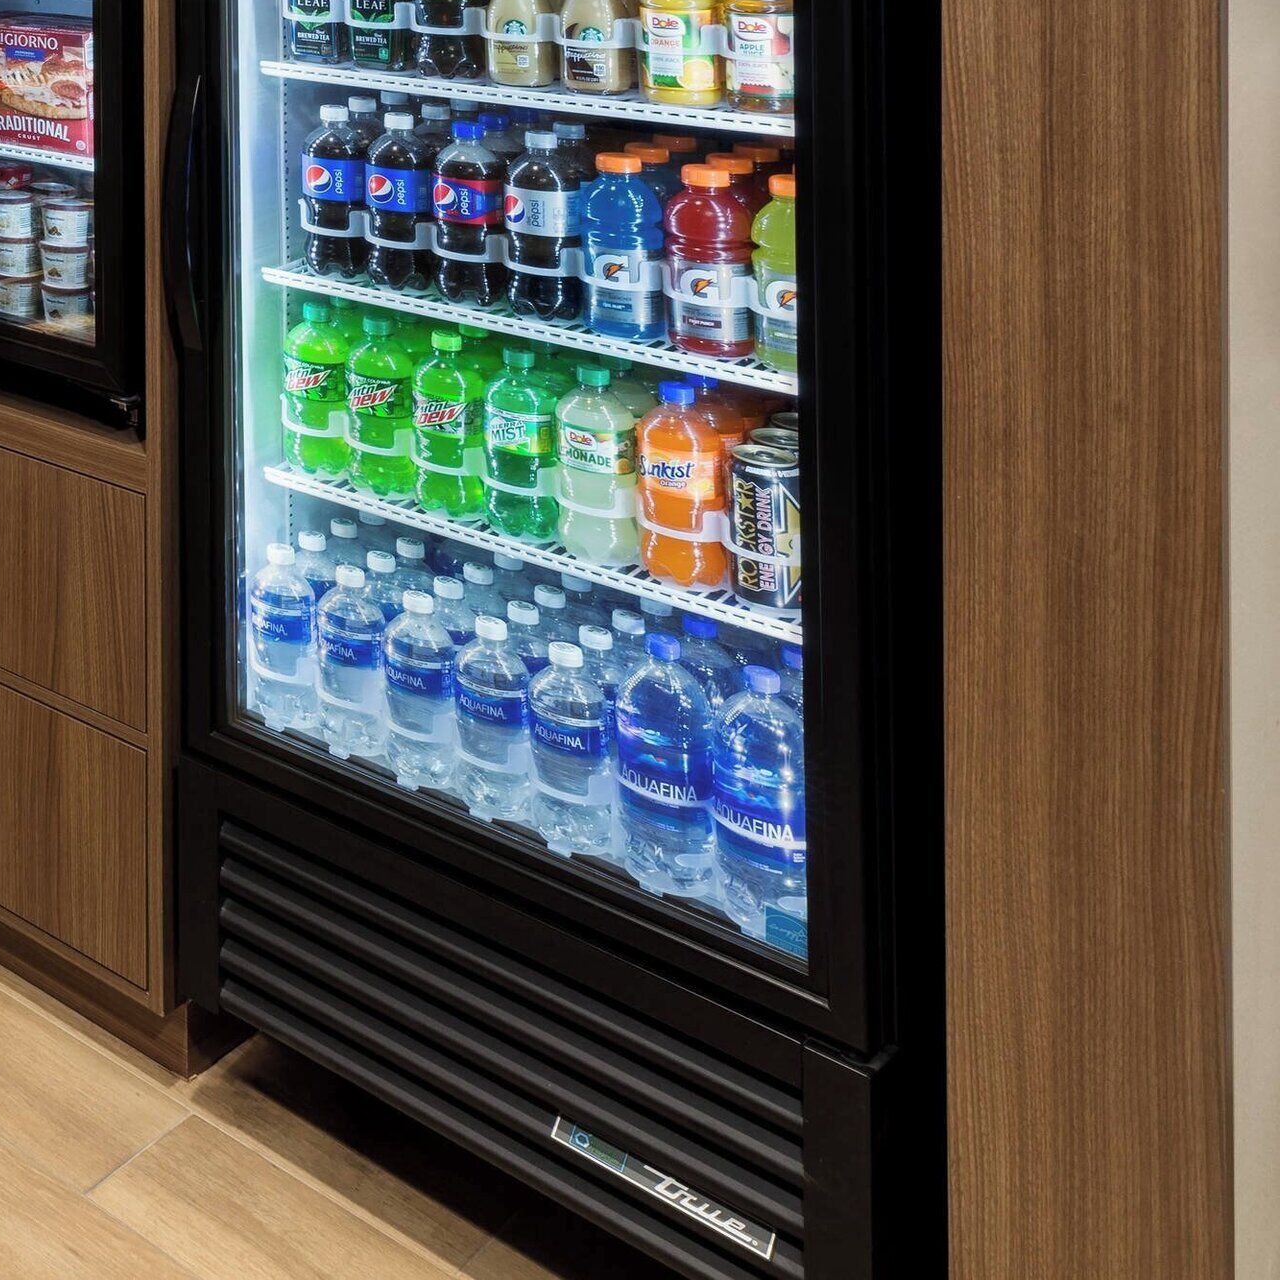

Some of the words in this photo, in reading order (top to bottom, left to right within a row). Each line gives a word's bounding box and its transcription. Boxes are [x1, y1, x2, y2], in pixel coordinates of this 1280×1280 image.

[297, 31, 319, 39] BREWED
[652, 17, 679, 28] Dole
[738, 21, 766, 32] Dole
[18, 133, 40, 141] CRUST
[334, 169, 343, 194] pepsi
[396, 179, 406, 205] pepsi
[460, 187, 471, 216] pepsi
[531, 199, 540, 228] pepsi
[491, 425, 525, 441] MIST
[569, 431, 592, 446] Dole
[640, 454, 696, 479] Sunkist
[659, 479, 687, 489] Orange
[755, 487, 773, 532] DRINK
[385, 665, 426, 689] AQUAFINA
[459, 693, 505, 718] AQUAFINA
[534, 723, 583, 750] AQUAFINA
[622, 762, 698, 802] AQUAFINA
[715, 798, 794, 842] AQUAFINA
